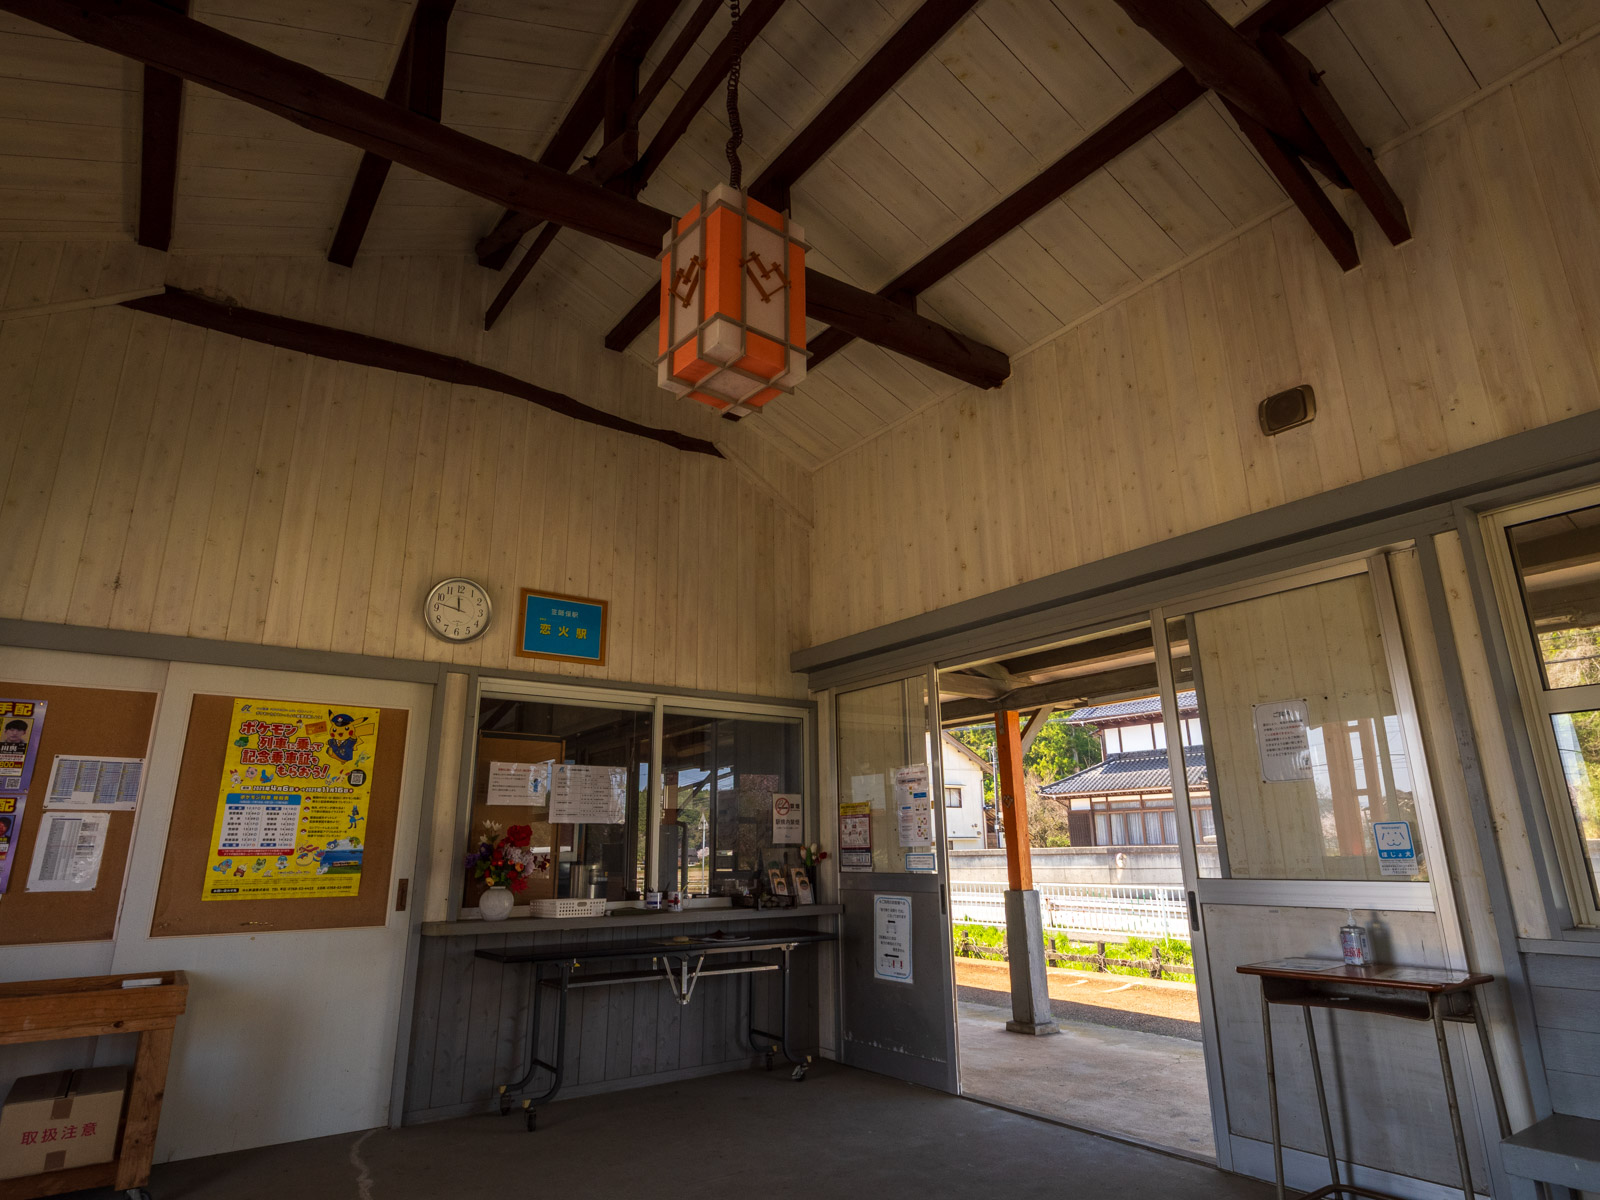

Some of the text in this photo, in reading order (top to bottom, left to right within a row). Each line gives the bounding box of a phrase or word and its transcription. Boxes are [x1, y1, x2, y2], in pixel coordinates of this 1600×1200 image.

[447, 586, 453, 595] 11
[458, 585, 466, 594] 12
[438, 593, 445, 601] 10
[476, 598, 482, 606] 2
[434, 603, 440, 612] 9
[478, 609, 483, 618] 3
[436, 615, 441, 623] 8
[444, 624, 449, 632] 7
[454, 628, 459, 636] 6
[465, 627, 471, 635] 5
[539, 623, 587, 639] 恋火駅
[0, 702, 33, 716] 手配
[240, 719, 298, 737] ポケモン
[258, 735, 324, 751] 列車に乗って
[240, 749, 320, 766] 記念乗車証を
[276, 763, 330, 779] もらおう!
[21, 1122, 98, 1146] 取扱注意
